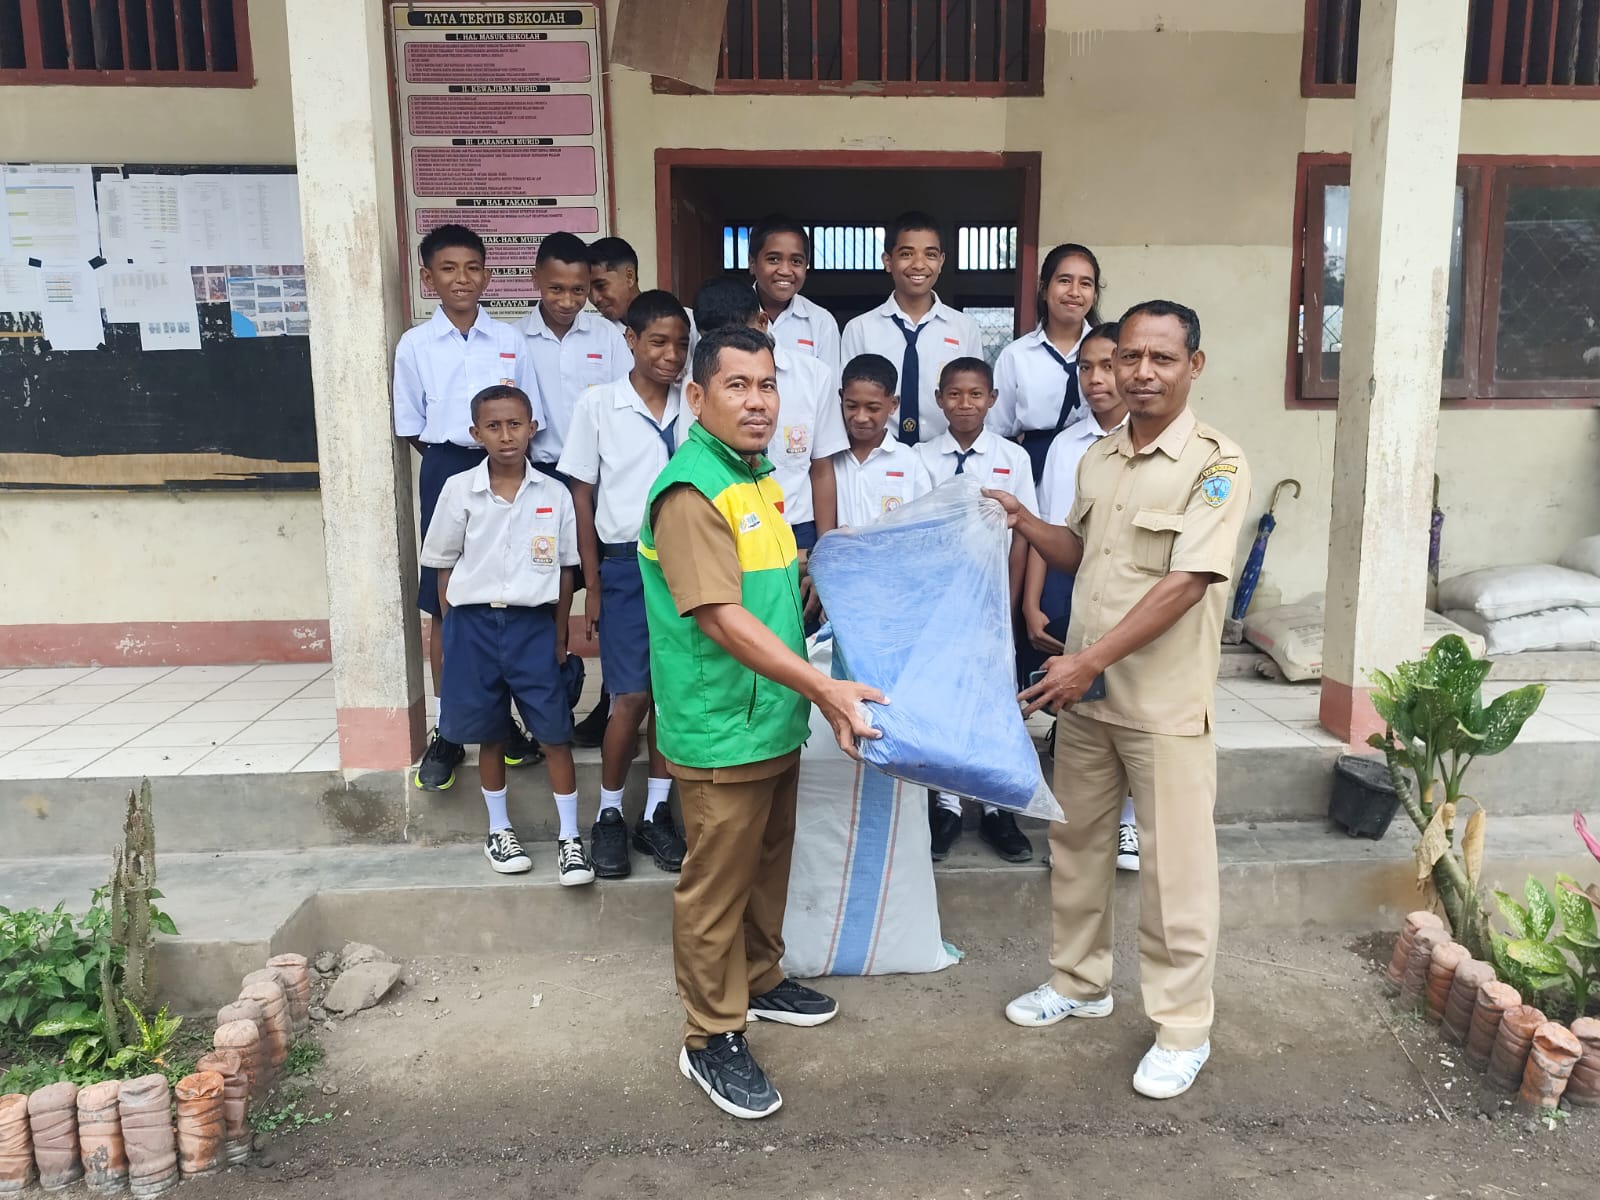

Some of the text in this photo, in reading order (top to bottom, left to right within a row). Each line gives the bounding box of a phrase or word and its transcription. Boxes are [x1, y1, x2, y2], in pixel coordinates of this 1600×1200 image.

[424, 12, 566, 24] TATA TERTIB SEKOLAH
